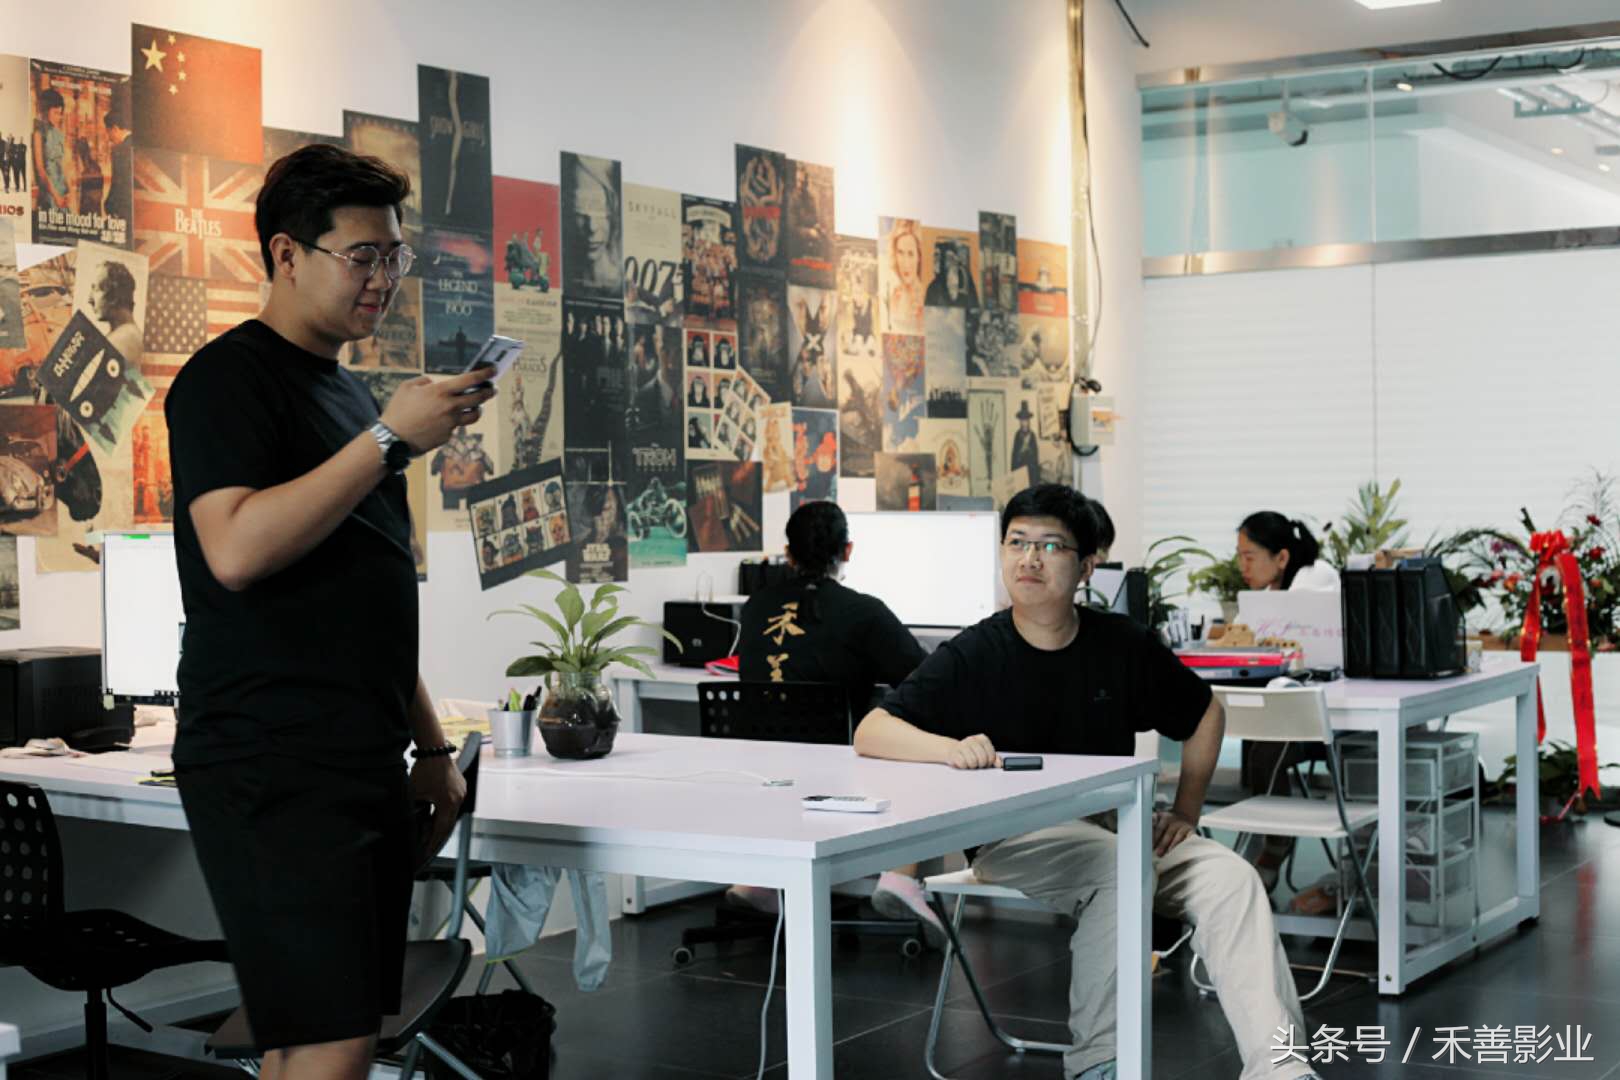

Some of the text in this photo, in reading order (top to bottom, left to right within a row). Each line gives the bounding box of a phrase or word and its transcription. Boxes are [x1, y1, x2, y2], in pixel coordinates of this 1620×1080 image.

[38, 207, 48, 223] in
[48, 208, 64, 225] the
[65, 212, 92, 229] mood
[93, 212, 105, 229] for
[107, 214, 126, 232] love
[175, 208, 222, 239] BEATLES
[624, 256, 677, 297] 007
